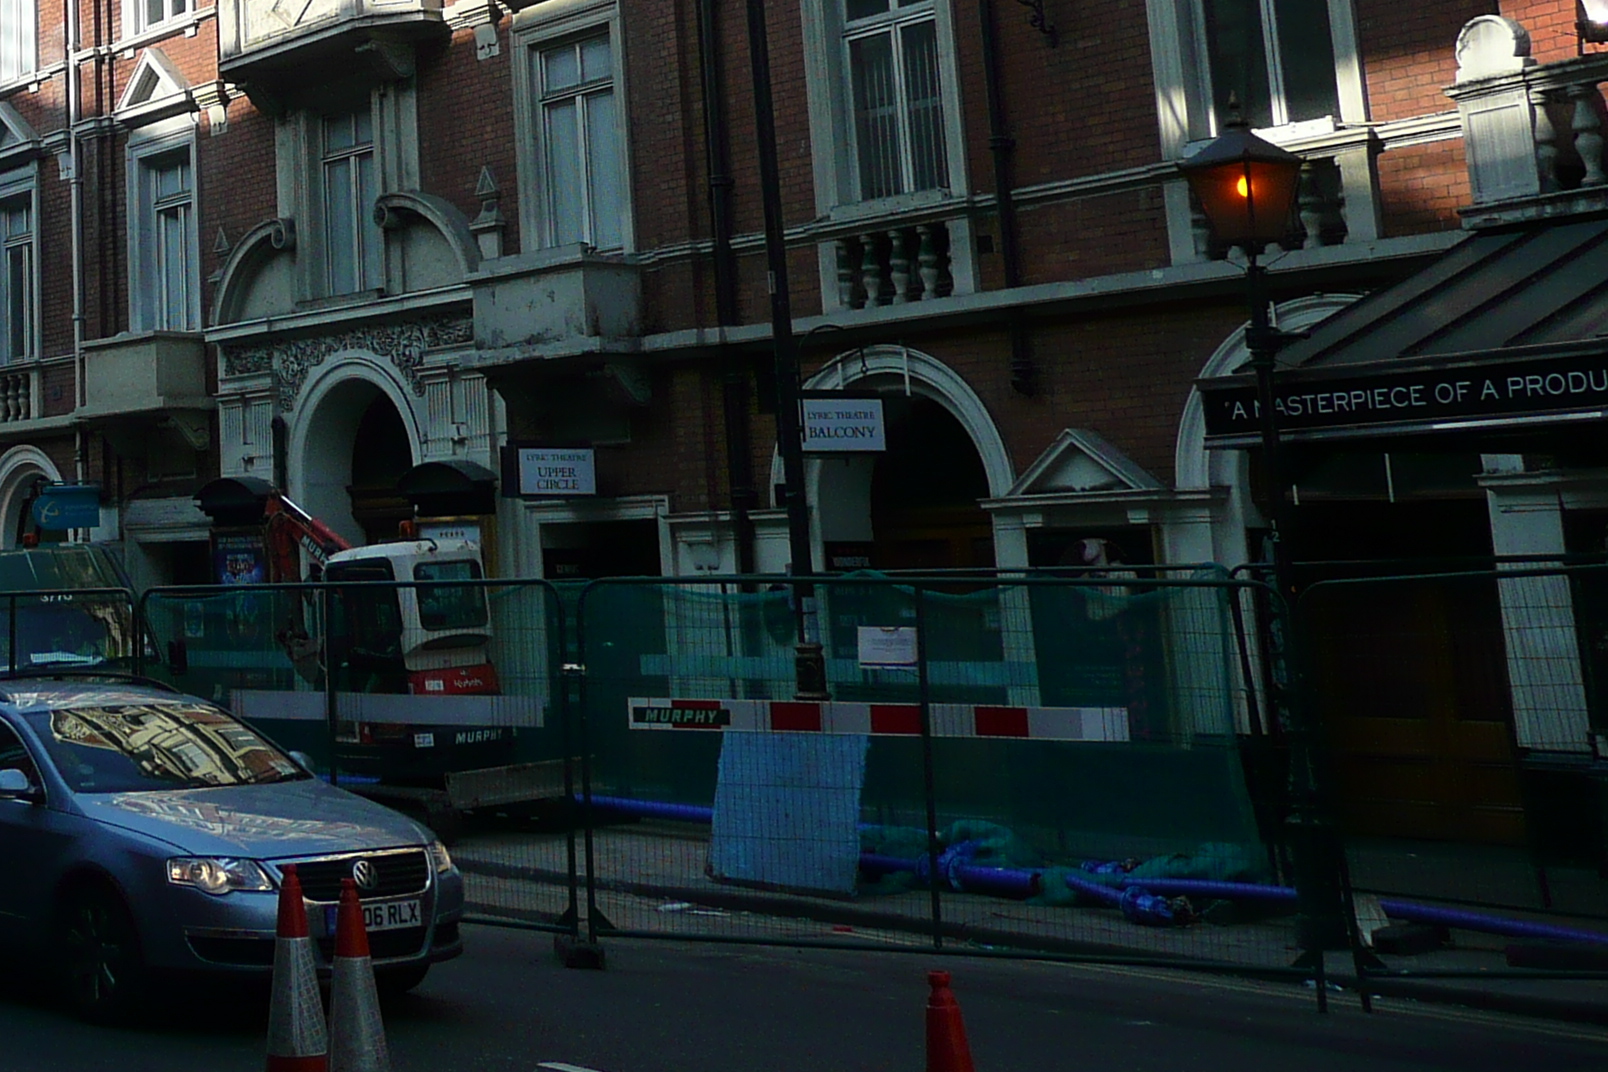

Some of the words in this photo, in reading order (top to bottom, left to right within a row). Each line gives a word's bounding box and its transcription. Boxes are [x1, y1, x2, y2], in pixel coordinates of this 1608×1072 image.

[1434, 380, 1471, 405] OF
[1479, 379, 1499, 401] A
[1506, 368, 1608, 399] PRODU
[809, 426, 876, 438] BALCONY
[538, 467, 577, 478] UPPER
[537, 479, 579, 490] CIRCLE
[644, 708, 718, 724] MURPHY
[455, 729, 503, 745] MURPHY
[388, 902, 418, 925] RLX
